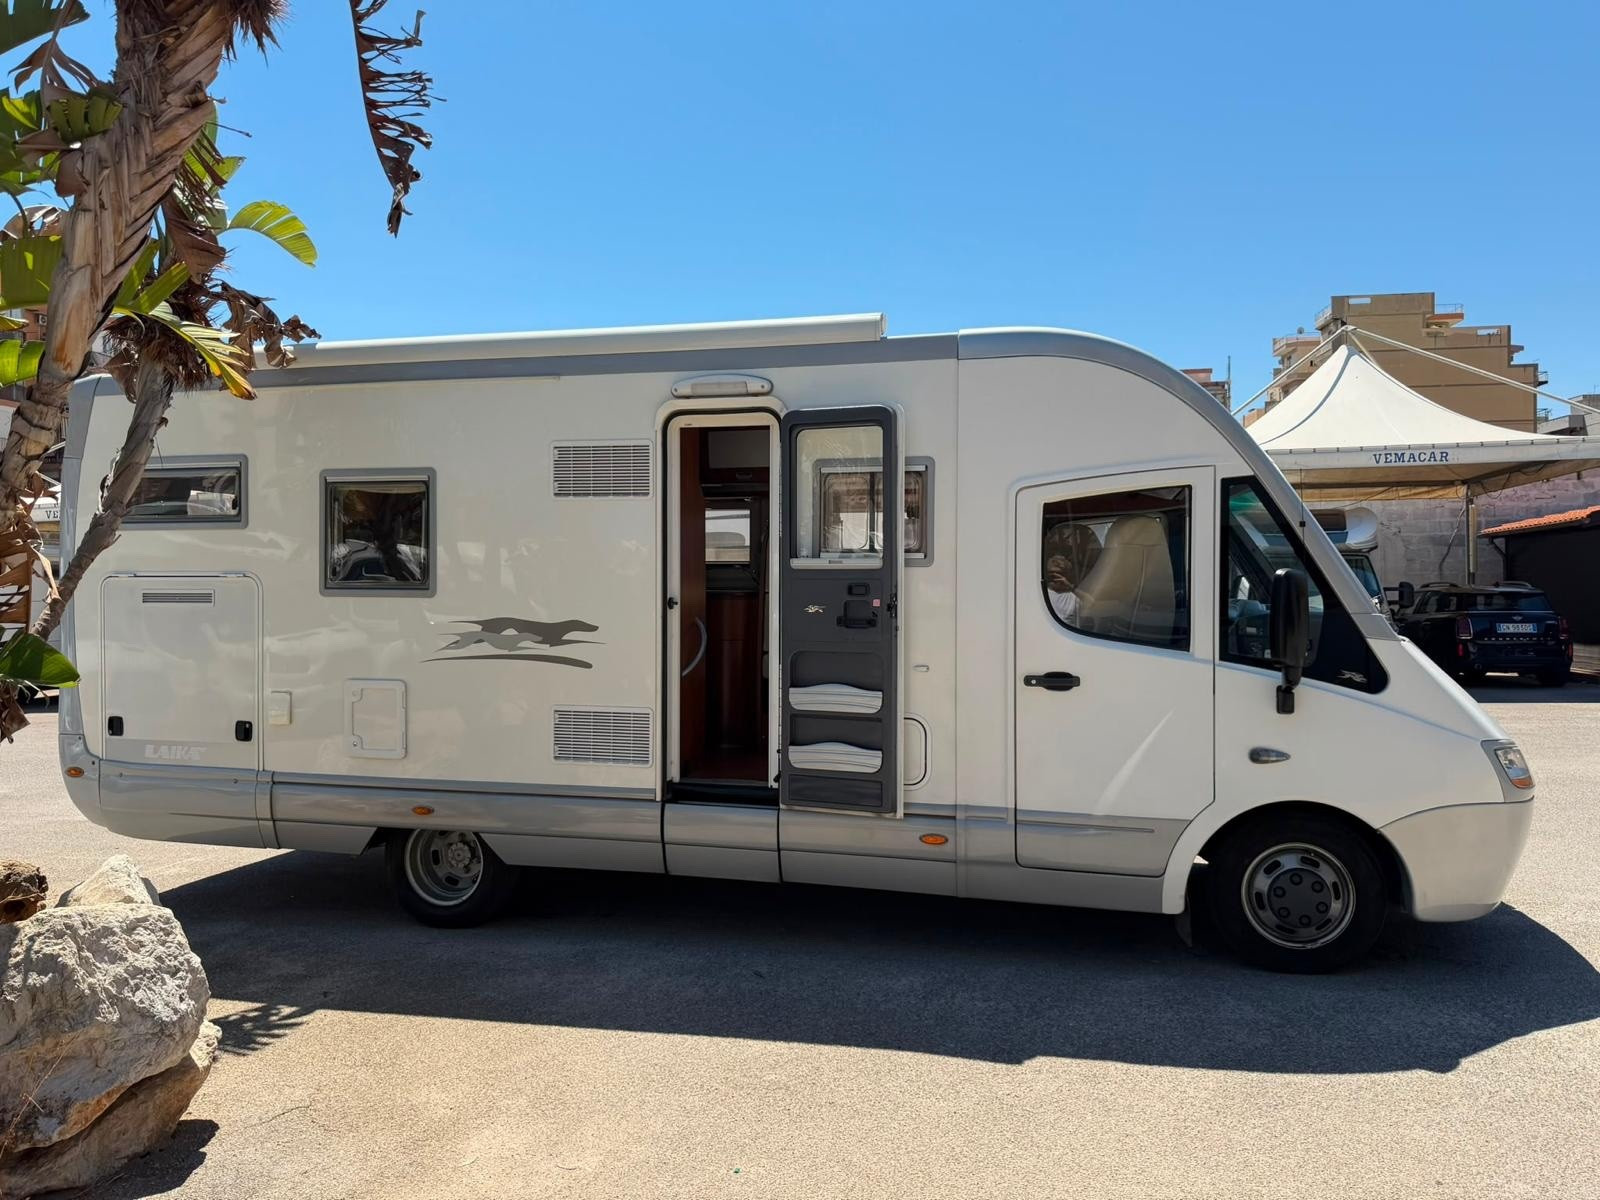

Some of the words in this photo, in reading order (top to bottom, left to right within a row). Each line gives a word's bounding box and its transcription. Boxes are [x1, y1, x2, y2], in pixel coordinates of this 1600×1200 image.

[1373, 451, 1449, 464] VEMACAR
[45, 510, 61, 519] VE
[144, 744, 208, 760] LAIKA
